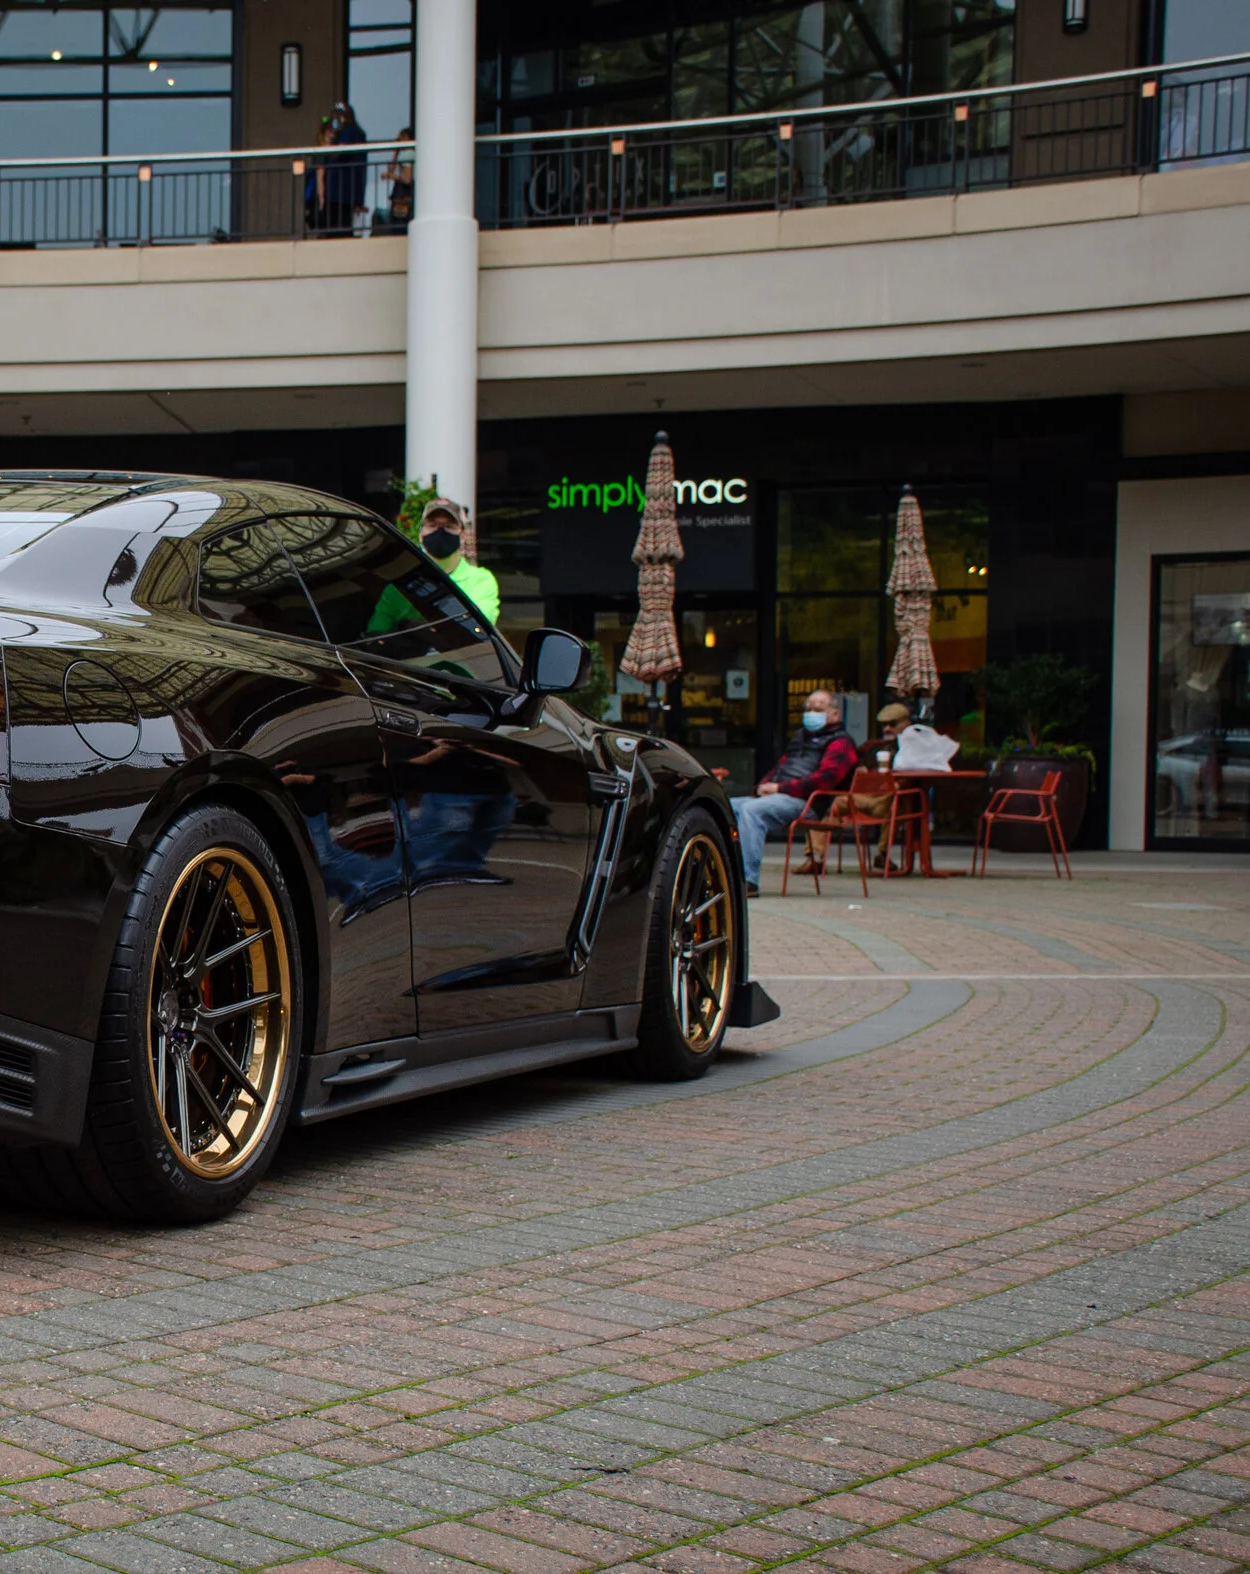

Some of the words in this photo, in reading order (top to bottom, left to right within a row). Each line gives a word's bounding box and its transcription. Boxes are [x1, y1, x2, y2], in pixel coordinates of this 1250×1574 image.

[546, 474, 647, 515] simply
[671, 477, 749, 505] mac
[695, 513, 752, 529] Specialist
